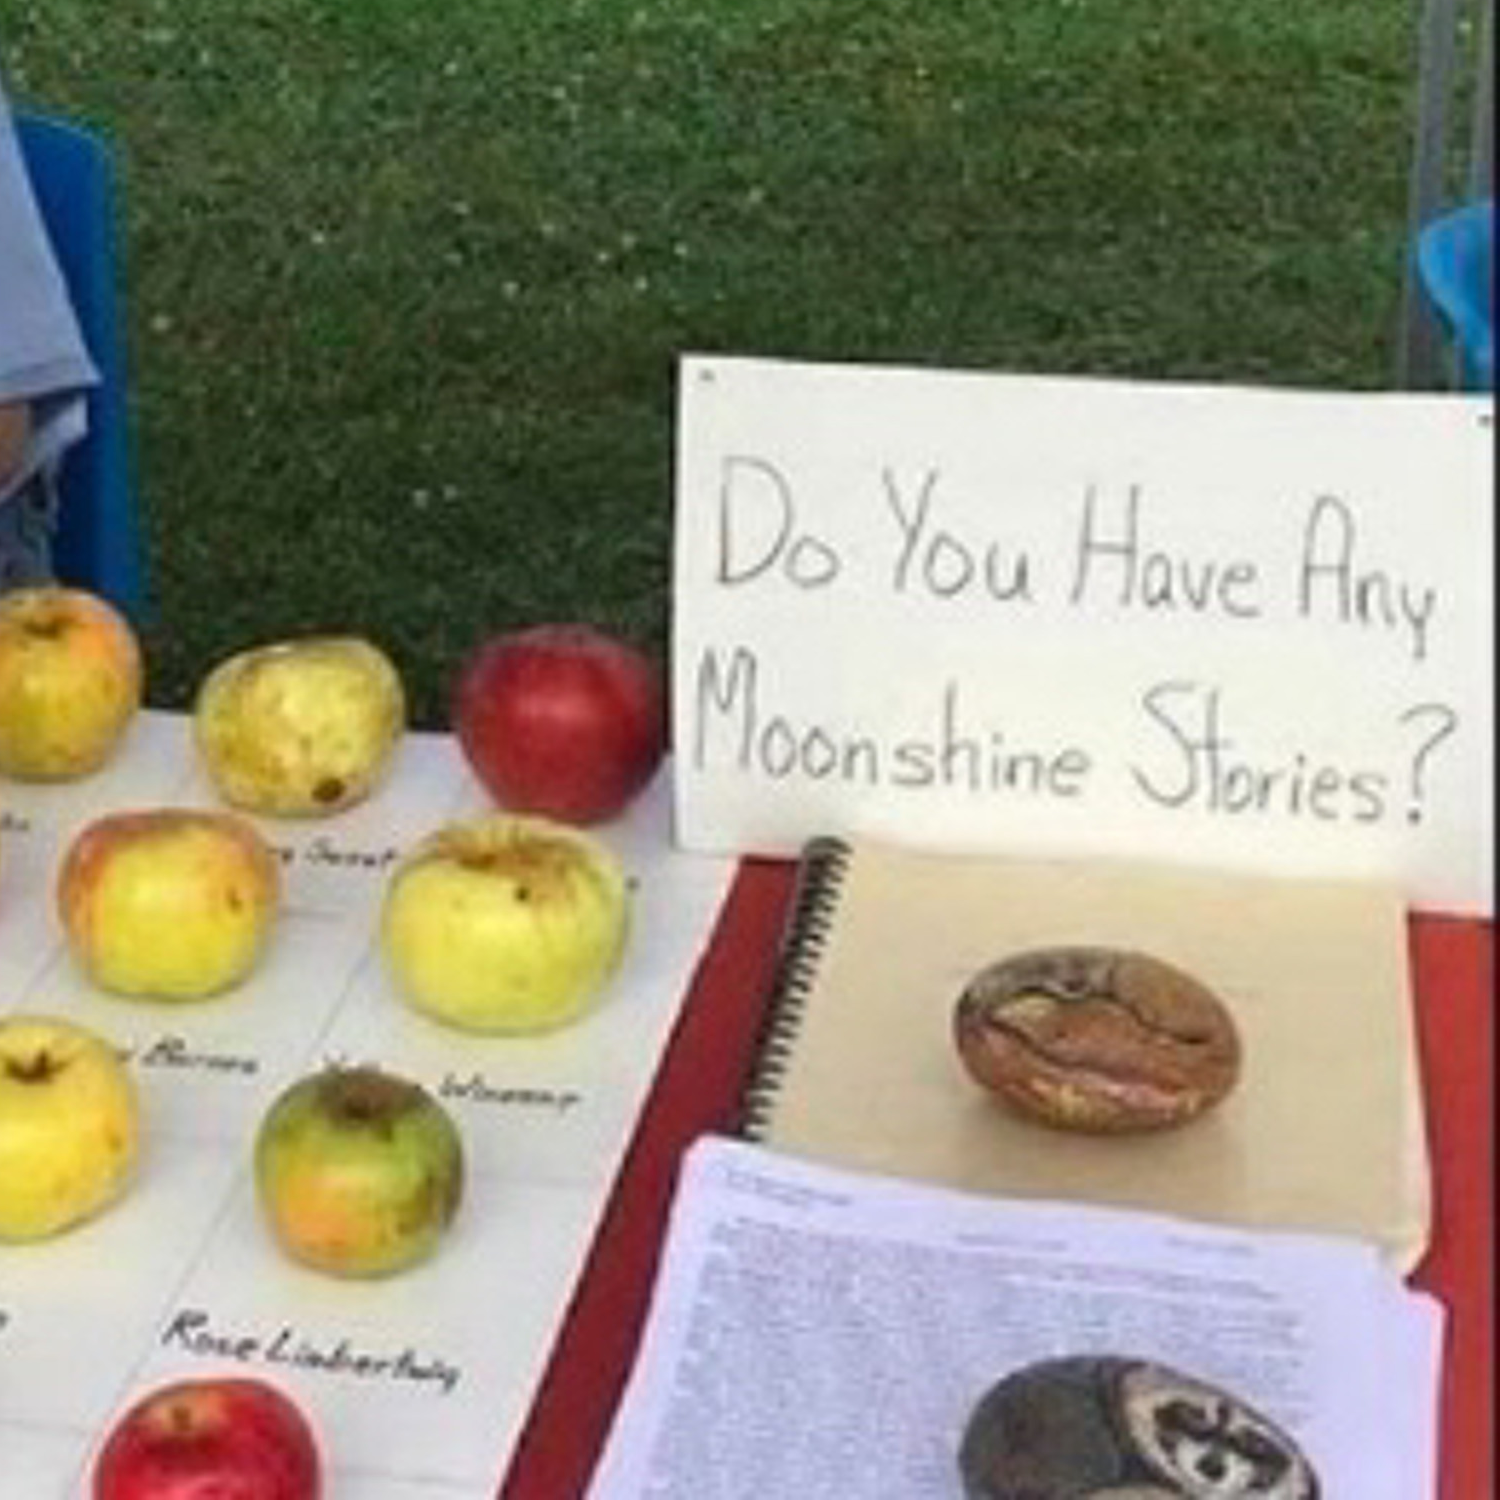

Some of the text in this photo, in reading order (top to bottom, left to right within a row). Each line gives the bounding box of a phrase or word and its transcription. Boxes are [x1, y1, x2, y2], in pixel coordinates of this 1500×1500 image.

[719, 455, 1438, 662] Do You Have Any
[696, 645, 1459, 826] Moonshine Stories?
